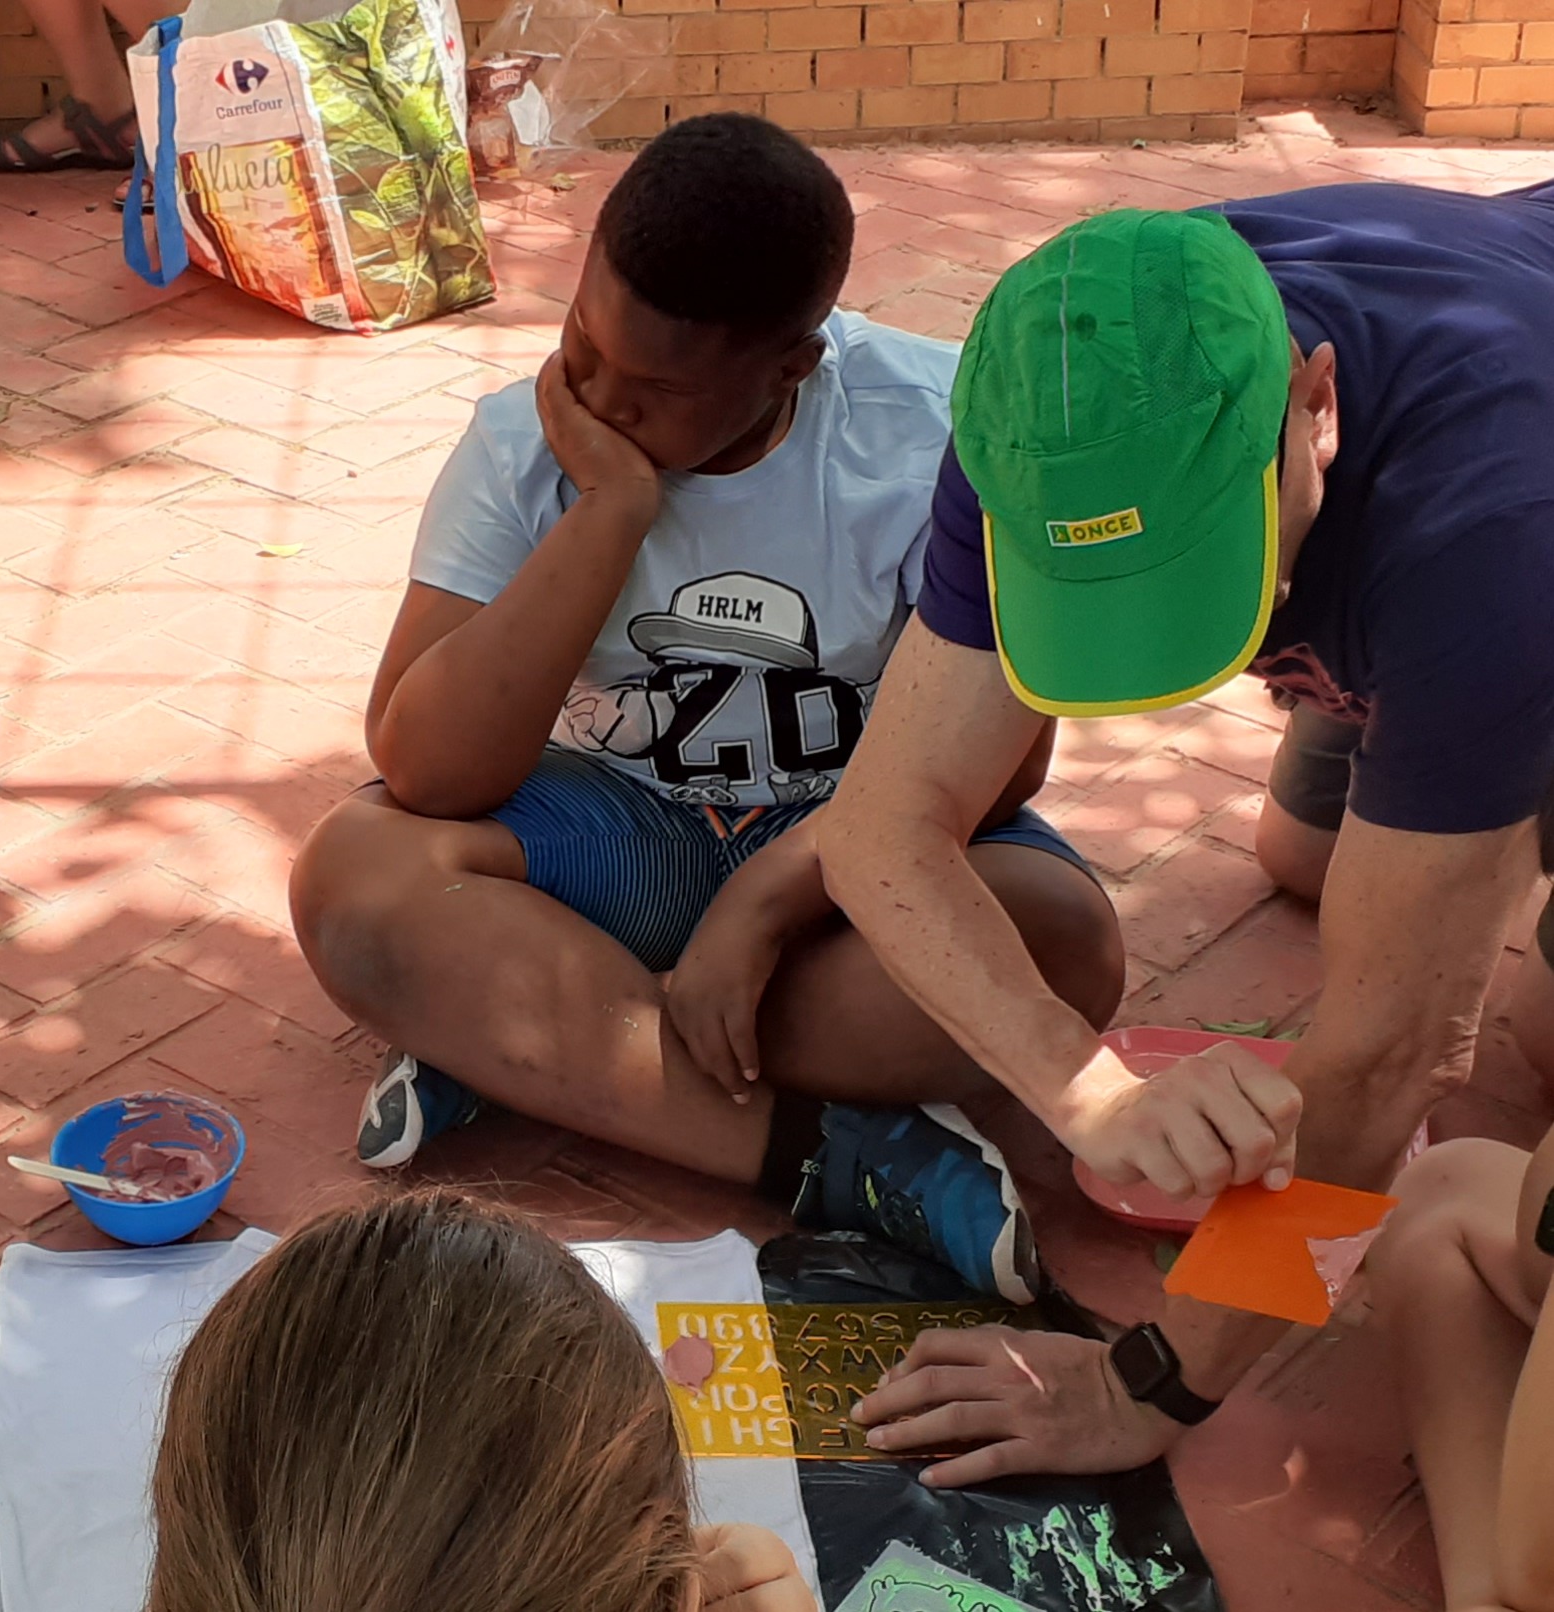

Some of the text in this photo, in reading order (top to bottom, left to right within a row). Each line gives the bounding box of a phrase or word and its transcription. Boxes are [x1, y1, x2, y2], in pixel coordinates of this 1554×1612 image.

[215, 97, 284, 121] Carrefour
[1072, 515, 1133, 541] ONCE
[696, 594, 765, 624] HRLM
